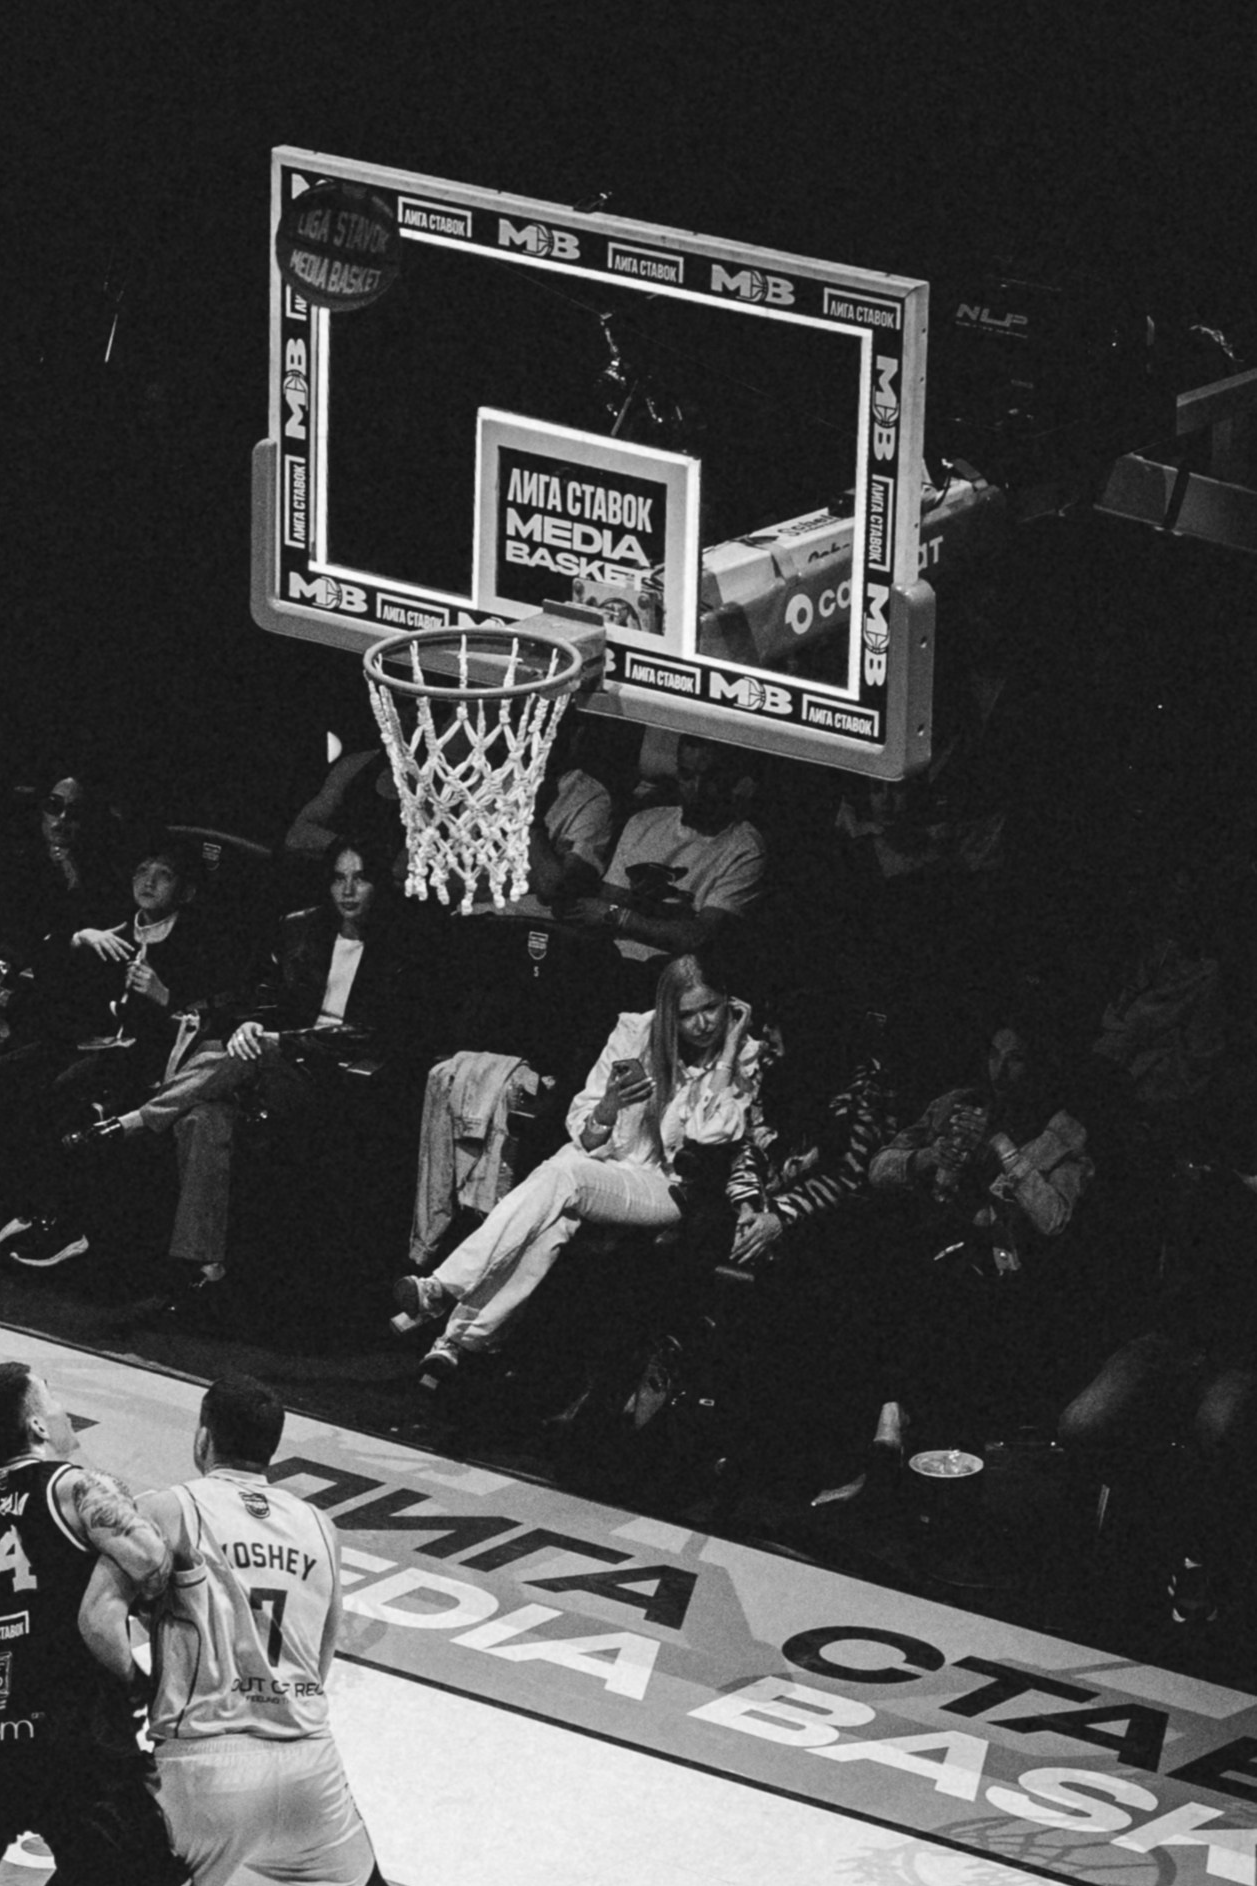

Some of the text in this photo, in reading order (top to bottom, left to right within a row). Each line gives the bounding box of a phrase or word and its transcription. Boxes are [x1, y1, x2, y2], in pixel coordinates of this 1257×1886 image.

[404, 209, 465, 237] ЛИГА СТАВОК
[289, 250, 382, 294] MEDIA BASKET
[614, 254, 677, 283] ЛИГА СТАВОК
[829, 301, 894, 330] ЛИГА СТАВОК
[293, 464, 306, 541] ЛИГА СТАВОК
[507, 467, 653, 533] ЛИГА СТАВОК
[868, 482, 885, 562] ЛИГА СТАВОК
[506, 507, 651, 567] MEDIA
[506, 539, 654, 592] BASKET
[382, 604, 407, 624] ЛИГА
[631, 664, 694, 693] ЛИГА СТАВОК
[808, 706, 872, 736] ЛИГА СТАВОК
[249, 1587, 288, 1668] 7
